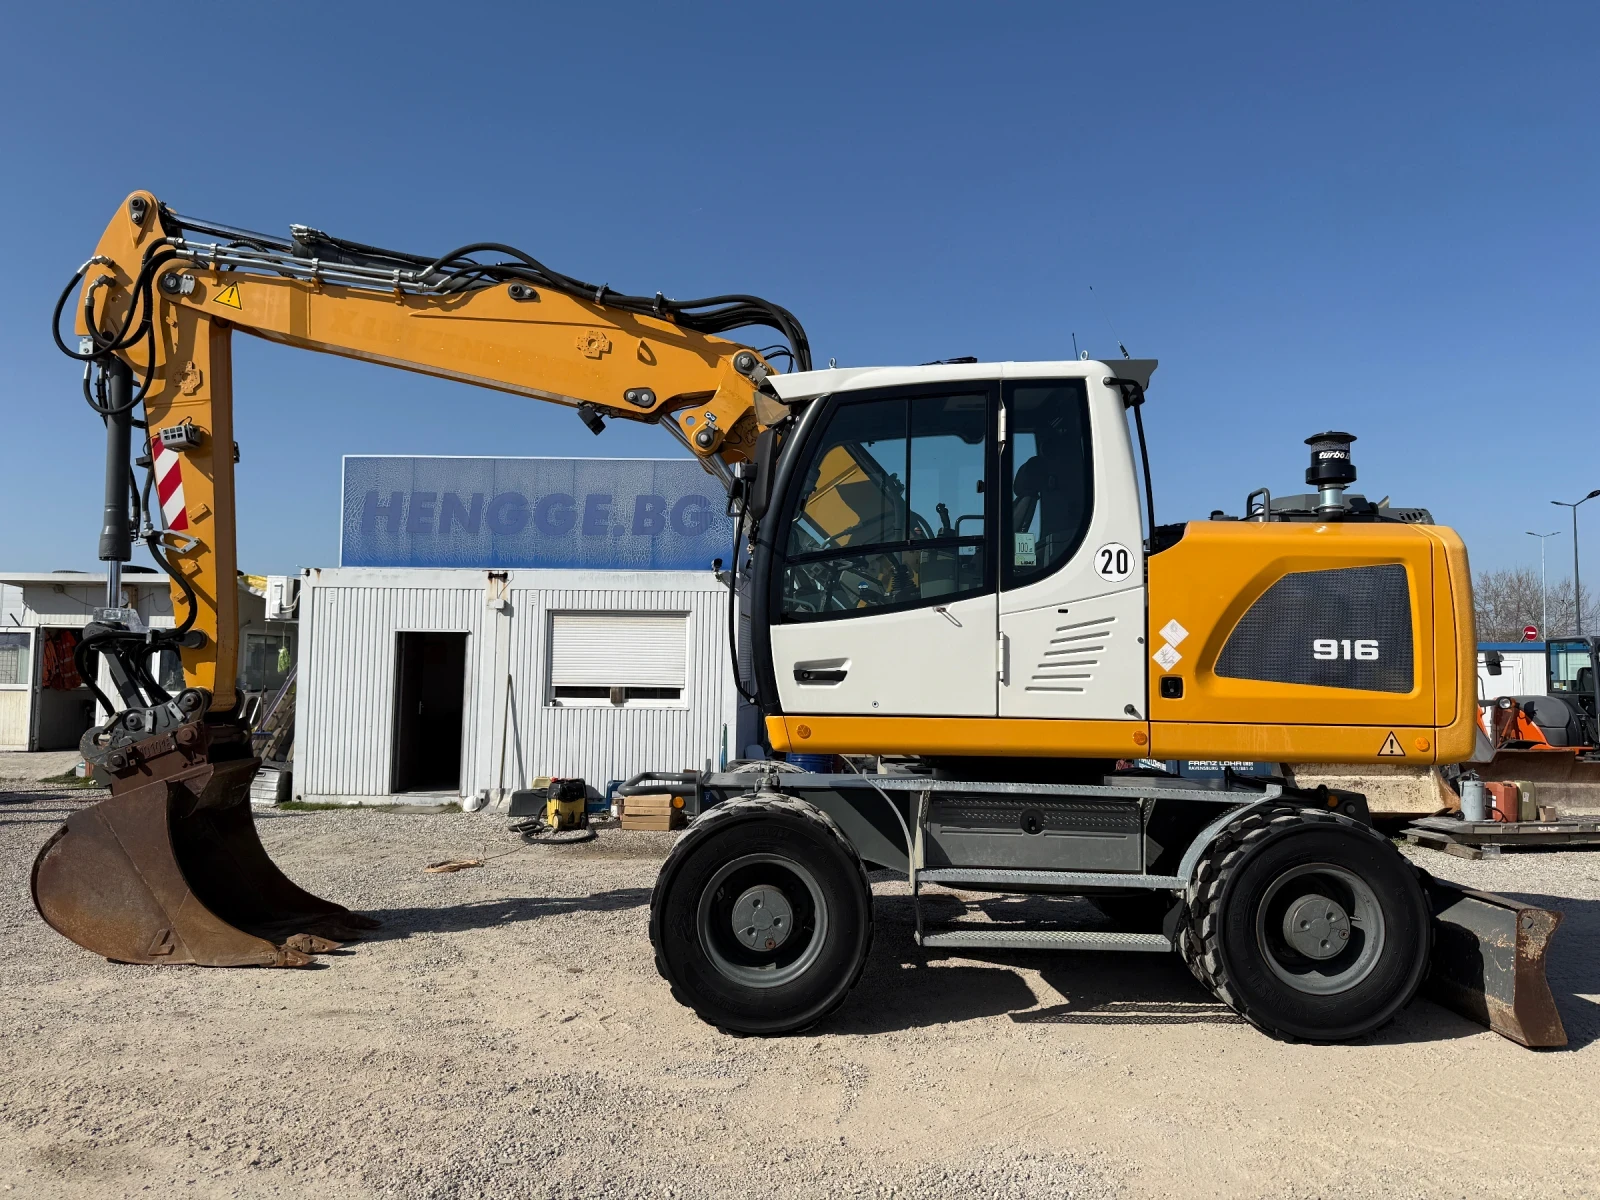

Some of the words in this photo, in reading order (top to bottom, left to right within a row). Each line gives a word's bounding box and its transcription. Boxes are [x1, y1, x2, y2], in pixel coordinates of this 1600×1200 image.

[1319, 451, 1345, 459] turbo
[361, 491, 712, 537] HENGGE.BG
[1018, 542, 1028, 552] 100
[1101, 549, 1128, 574] 20
[1313, 638, 1379, 660] 916
